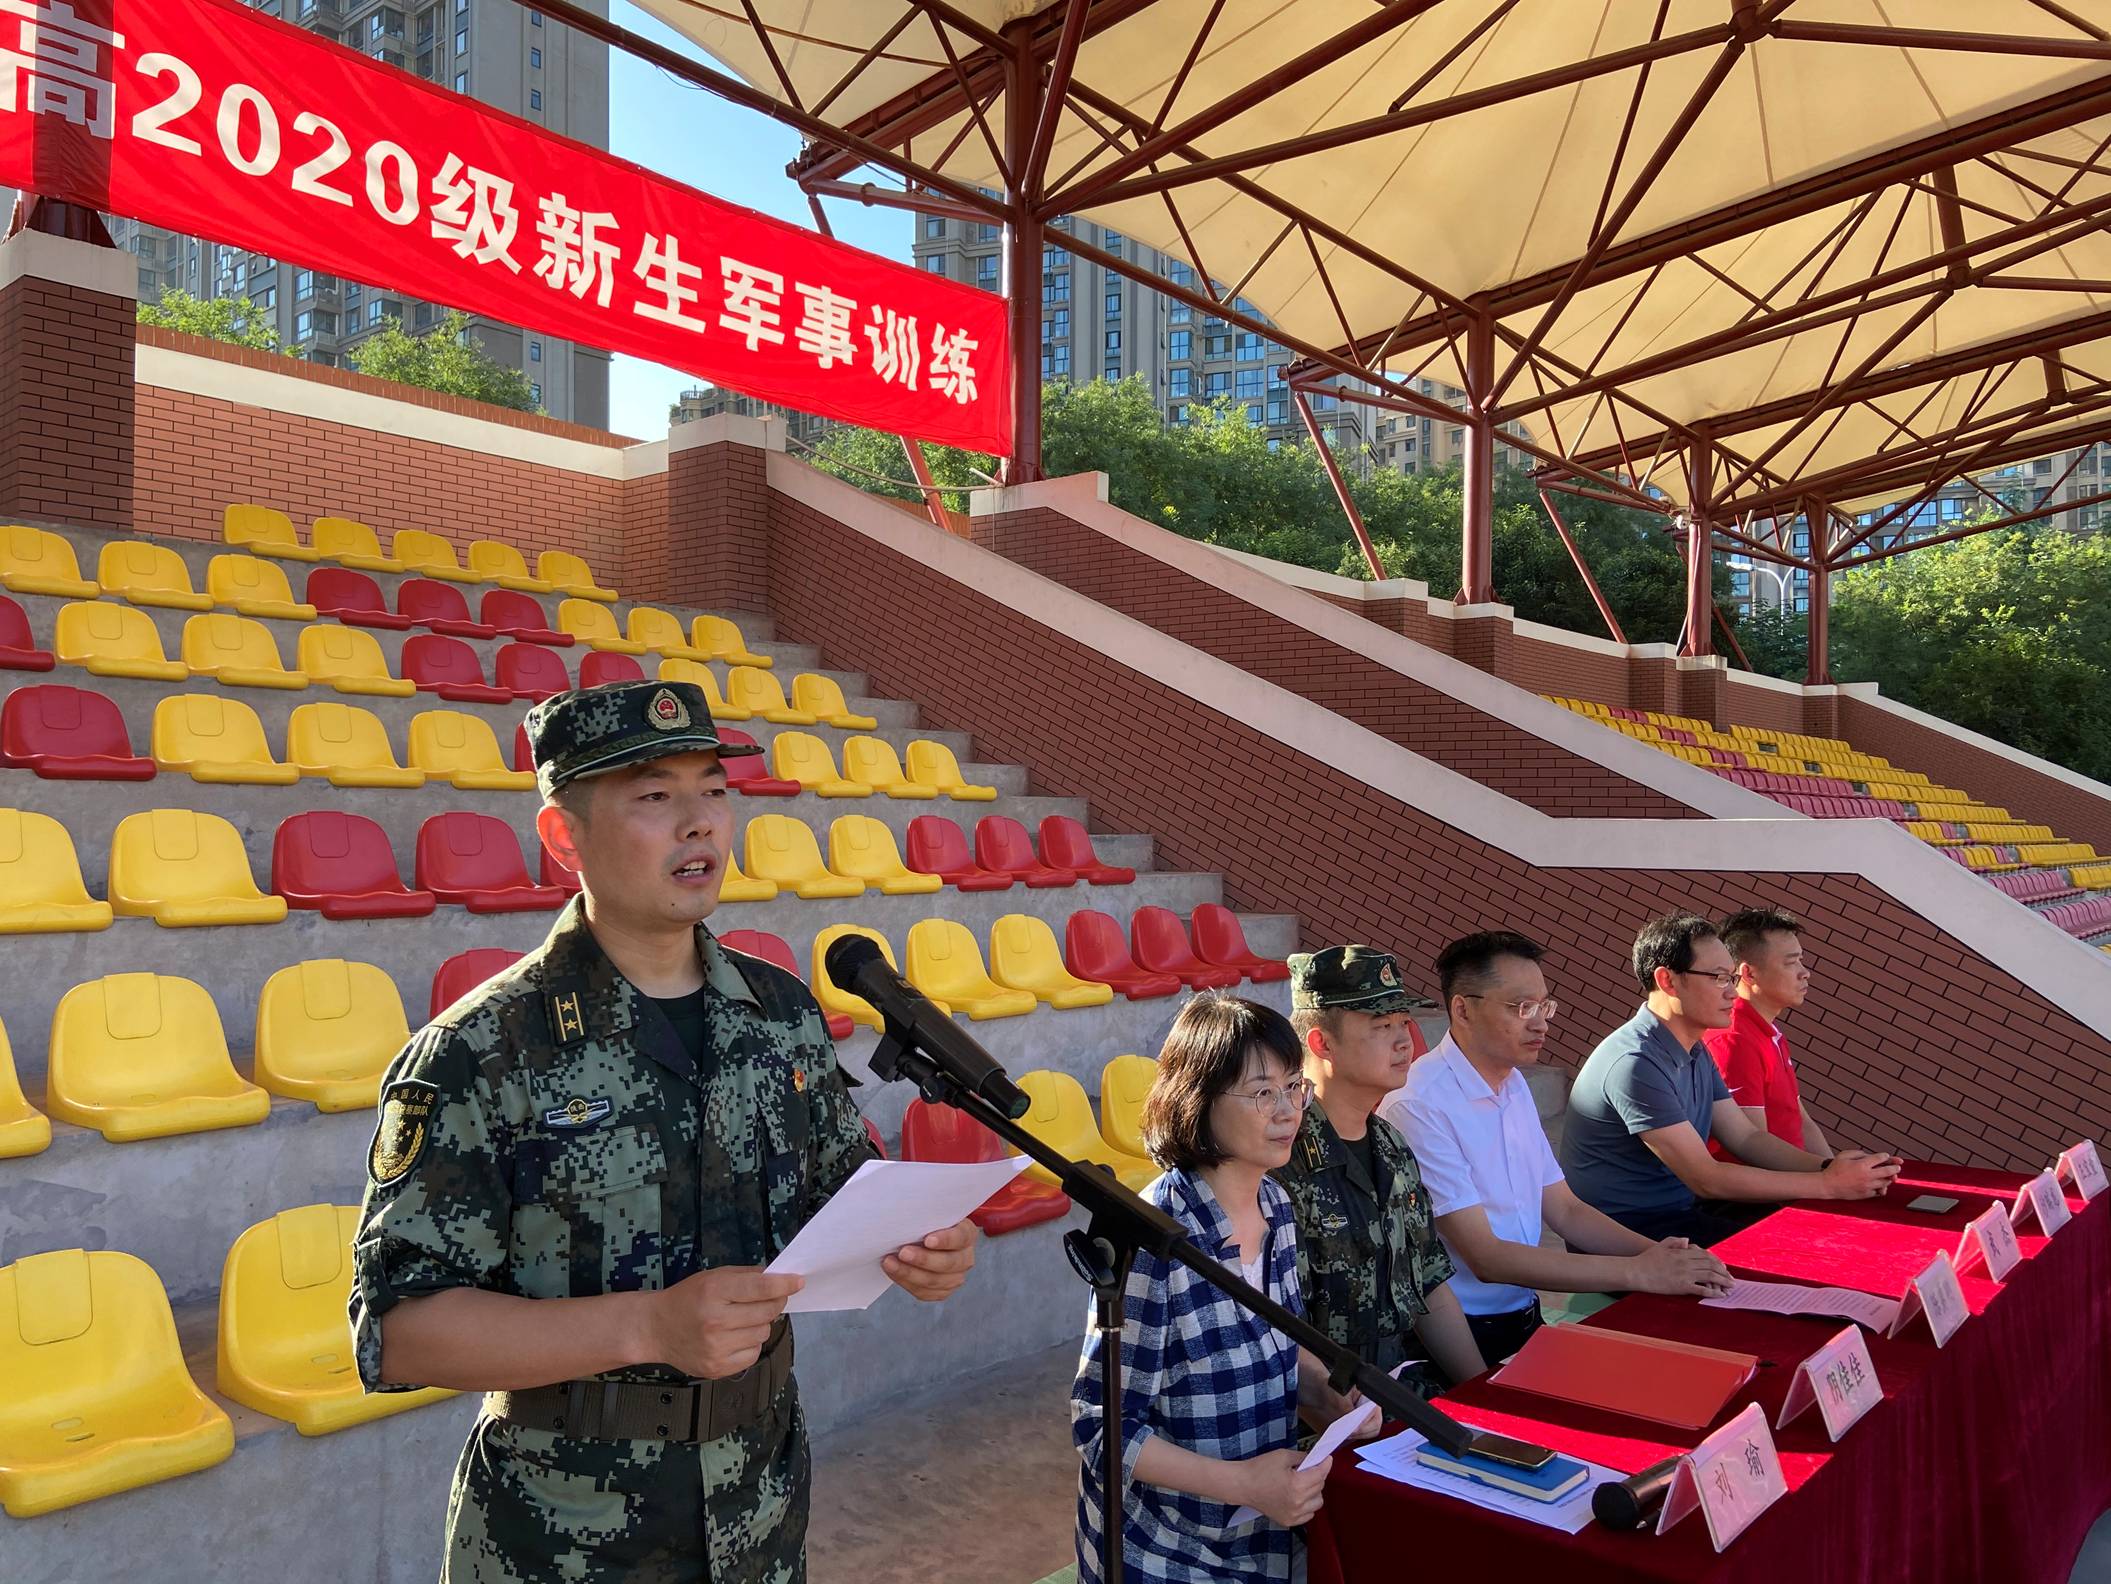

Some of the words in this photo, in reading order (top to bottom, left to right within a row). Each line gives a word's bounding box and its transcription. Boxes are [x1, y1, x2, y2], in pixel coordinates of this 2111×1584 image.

[0, 0, 979, 406] 高2020级新生军事训练
